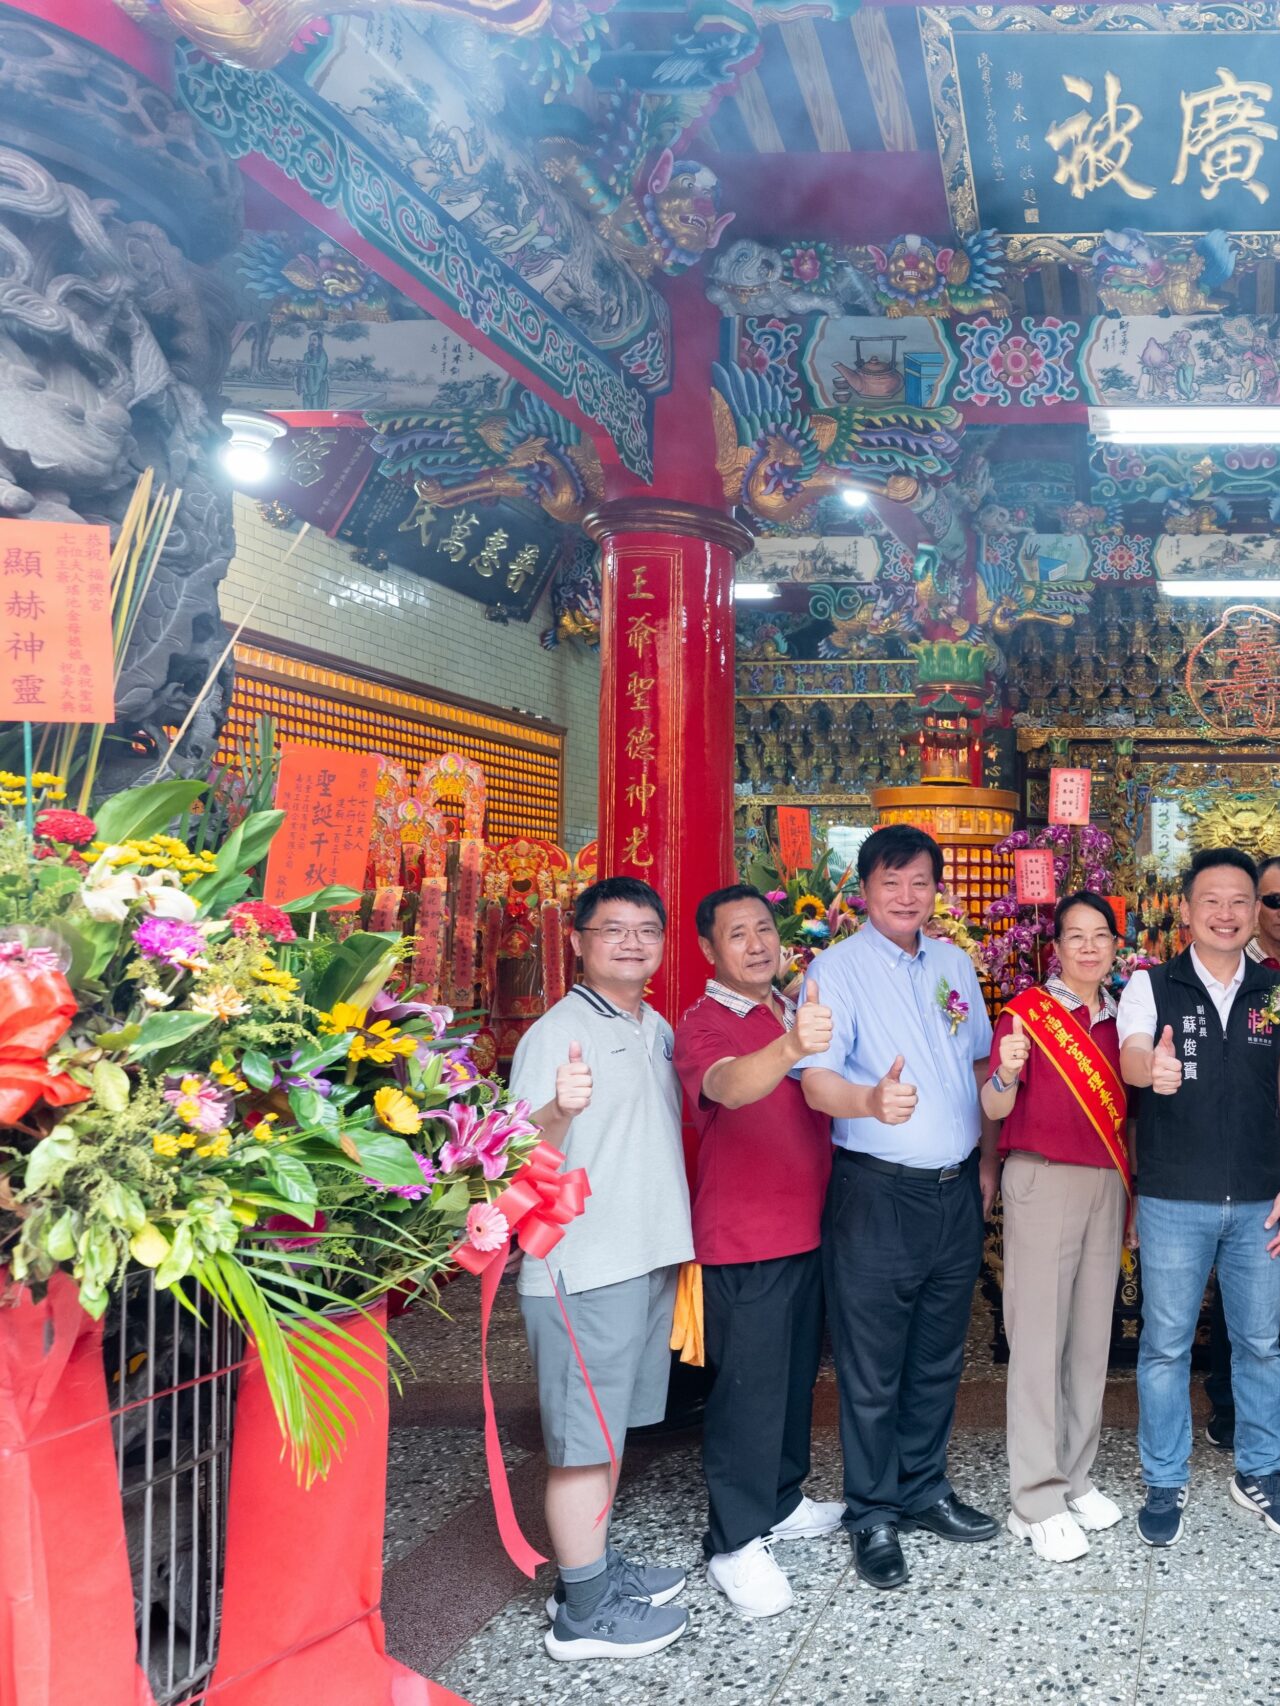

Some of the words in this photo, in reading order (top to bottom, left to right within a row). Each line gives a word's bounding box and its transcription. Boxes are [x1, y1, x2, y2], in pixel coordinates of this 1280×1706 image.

[3, 547, 47, 705] 顯赫神靈
[622, 565, 656, 868] 王爺聖德神光
[304, 769, 337, 887] 聖誕千秋
[1182, 1015, 1198, 1080] 蘇俊賓
[1196, 1004, 1208, 1038] 副市長
